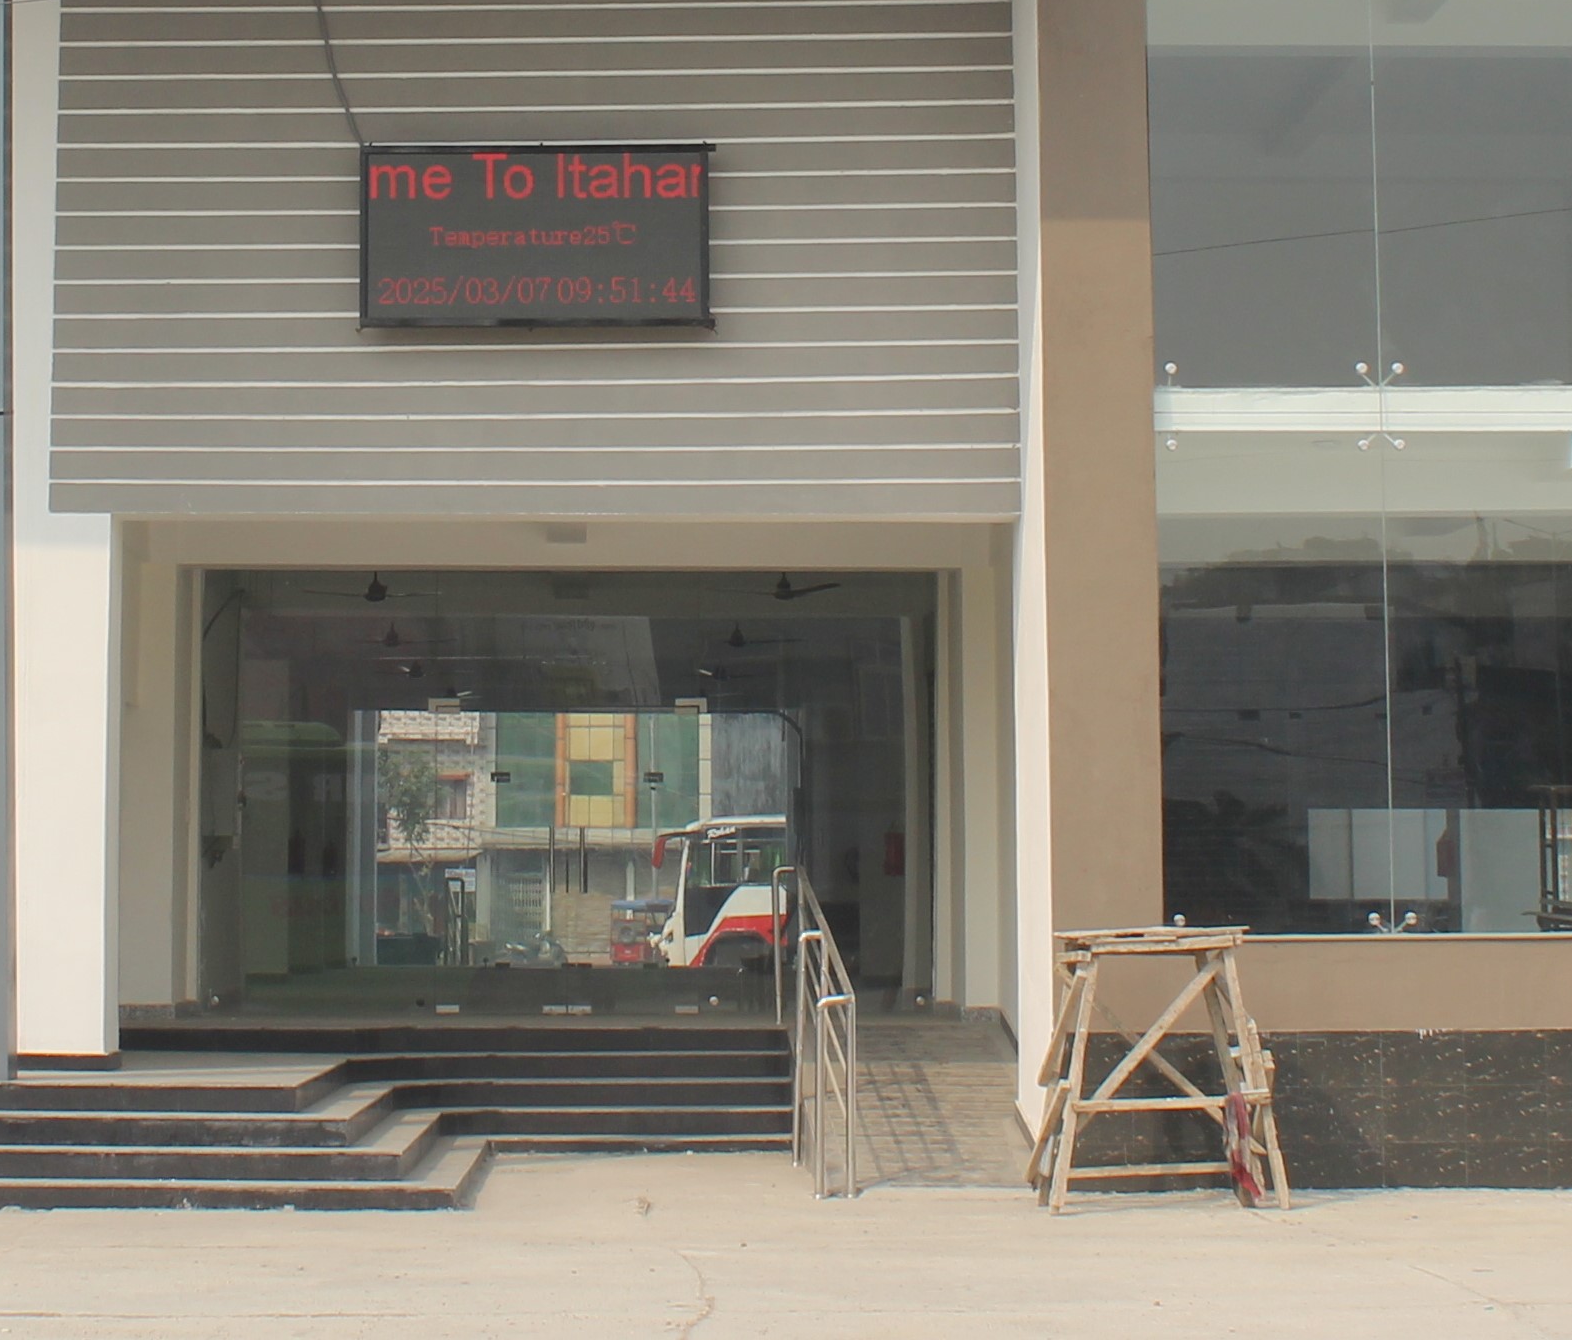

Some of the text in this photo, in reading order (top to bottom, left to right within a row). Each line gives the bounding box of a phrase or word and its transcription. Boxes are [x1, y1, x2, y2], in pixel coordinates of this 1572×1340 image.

[369, 163, 453, 200] me
[472, 152, 535, 200] To
[377, 276, 697, 306] 2025/03/07 09:51:44
